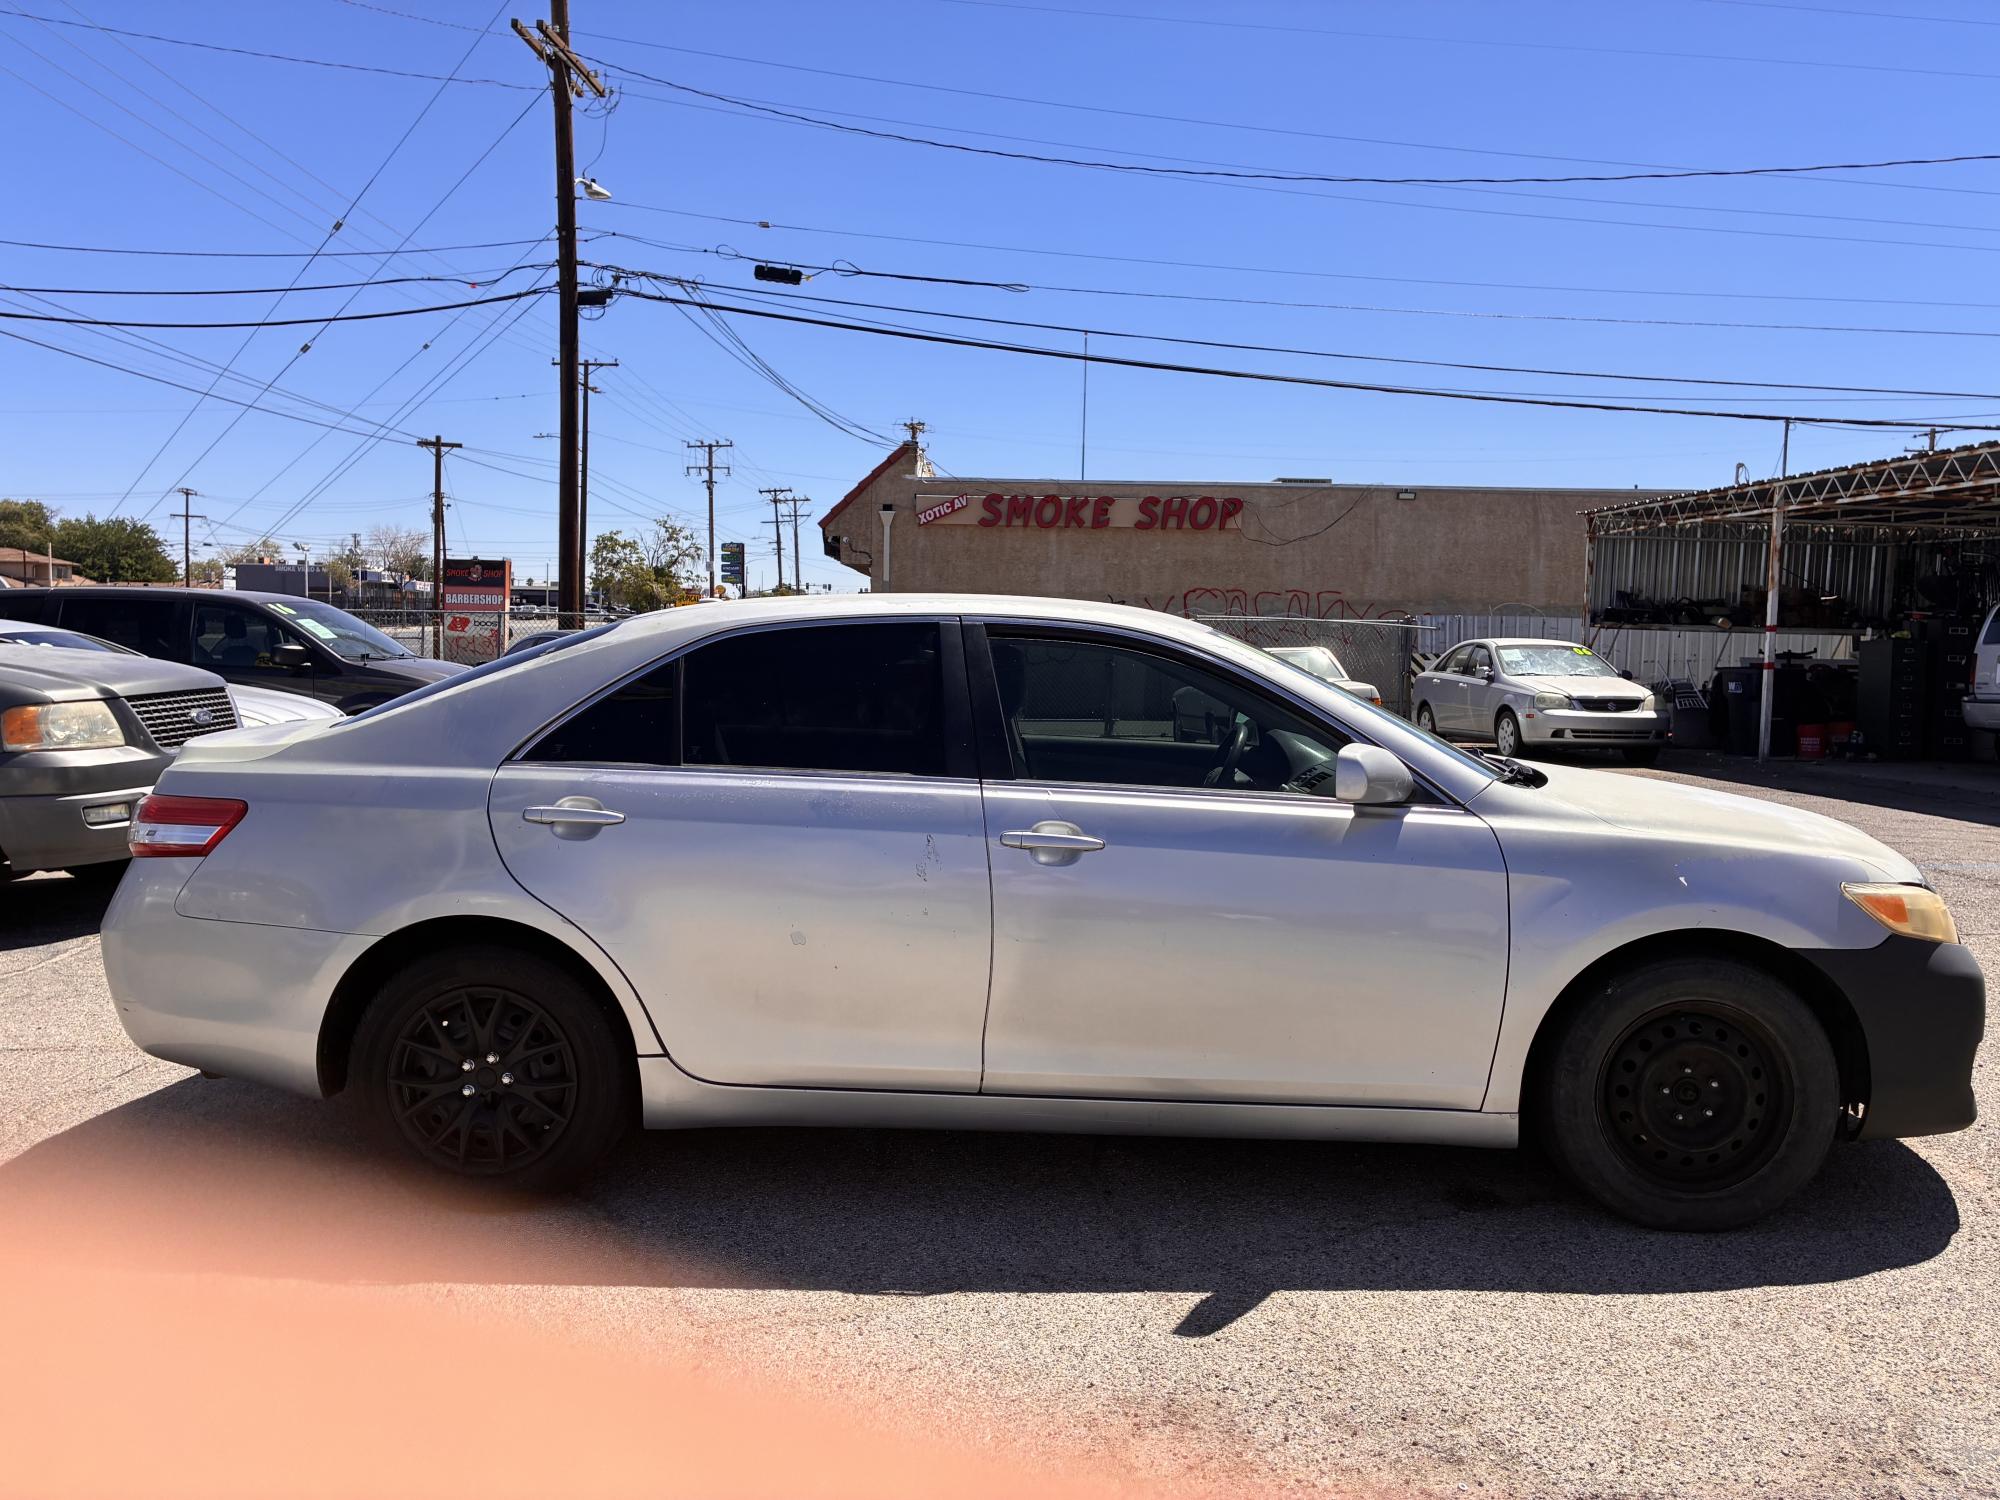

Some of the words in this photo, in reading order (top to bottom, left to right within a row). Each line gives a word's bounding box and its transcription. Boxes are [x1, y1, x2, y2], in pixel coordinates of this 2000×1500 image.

[918, 502, 952, 525] XOTIC
[977, 493, 1116, 529] SMOKE
[1134, 496, 1244, 530] SHOP
[446, 568, 469, 577] SMOKE
[482, 569, 504, 578] SHOP
[445, 593, 504, 604] BARBERSHOP
[473, 620, 500, 628] boos
